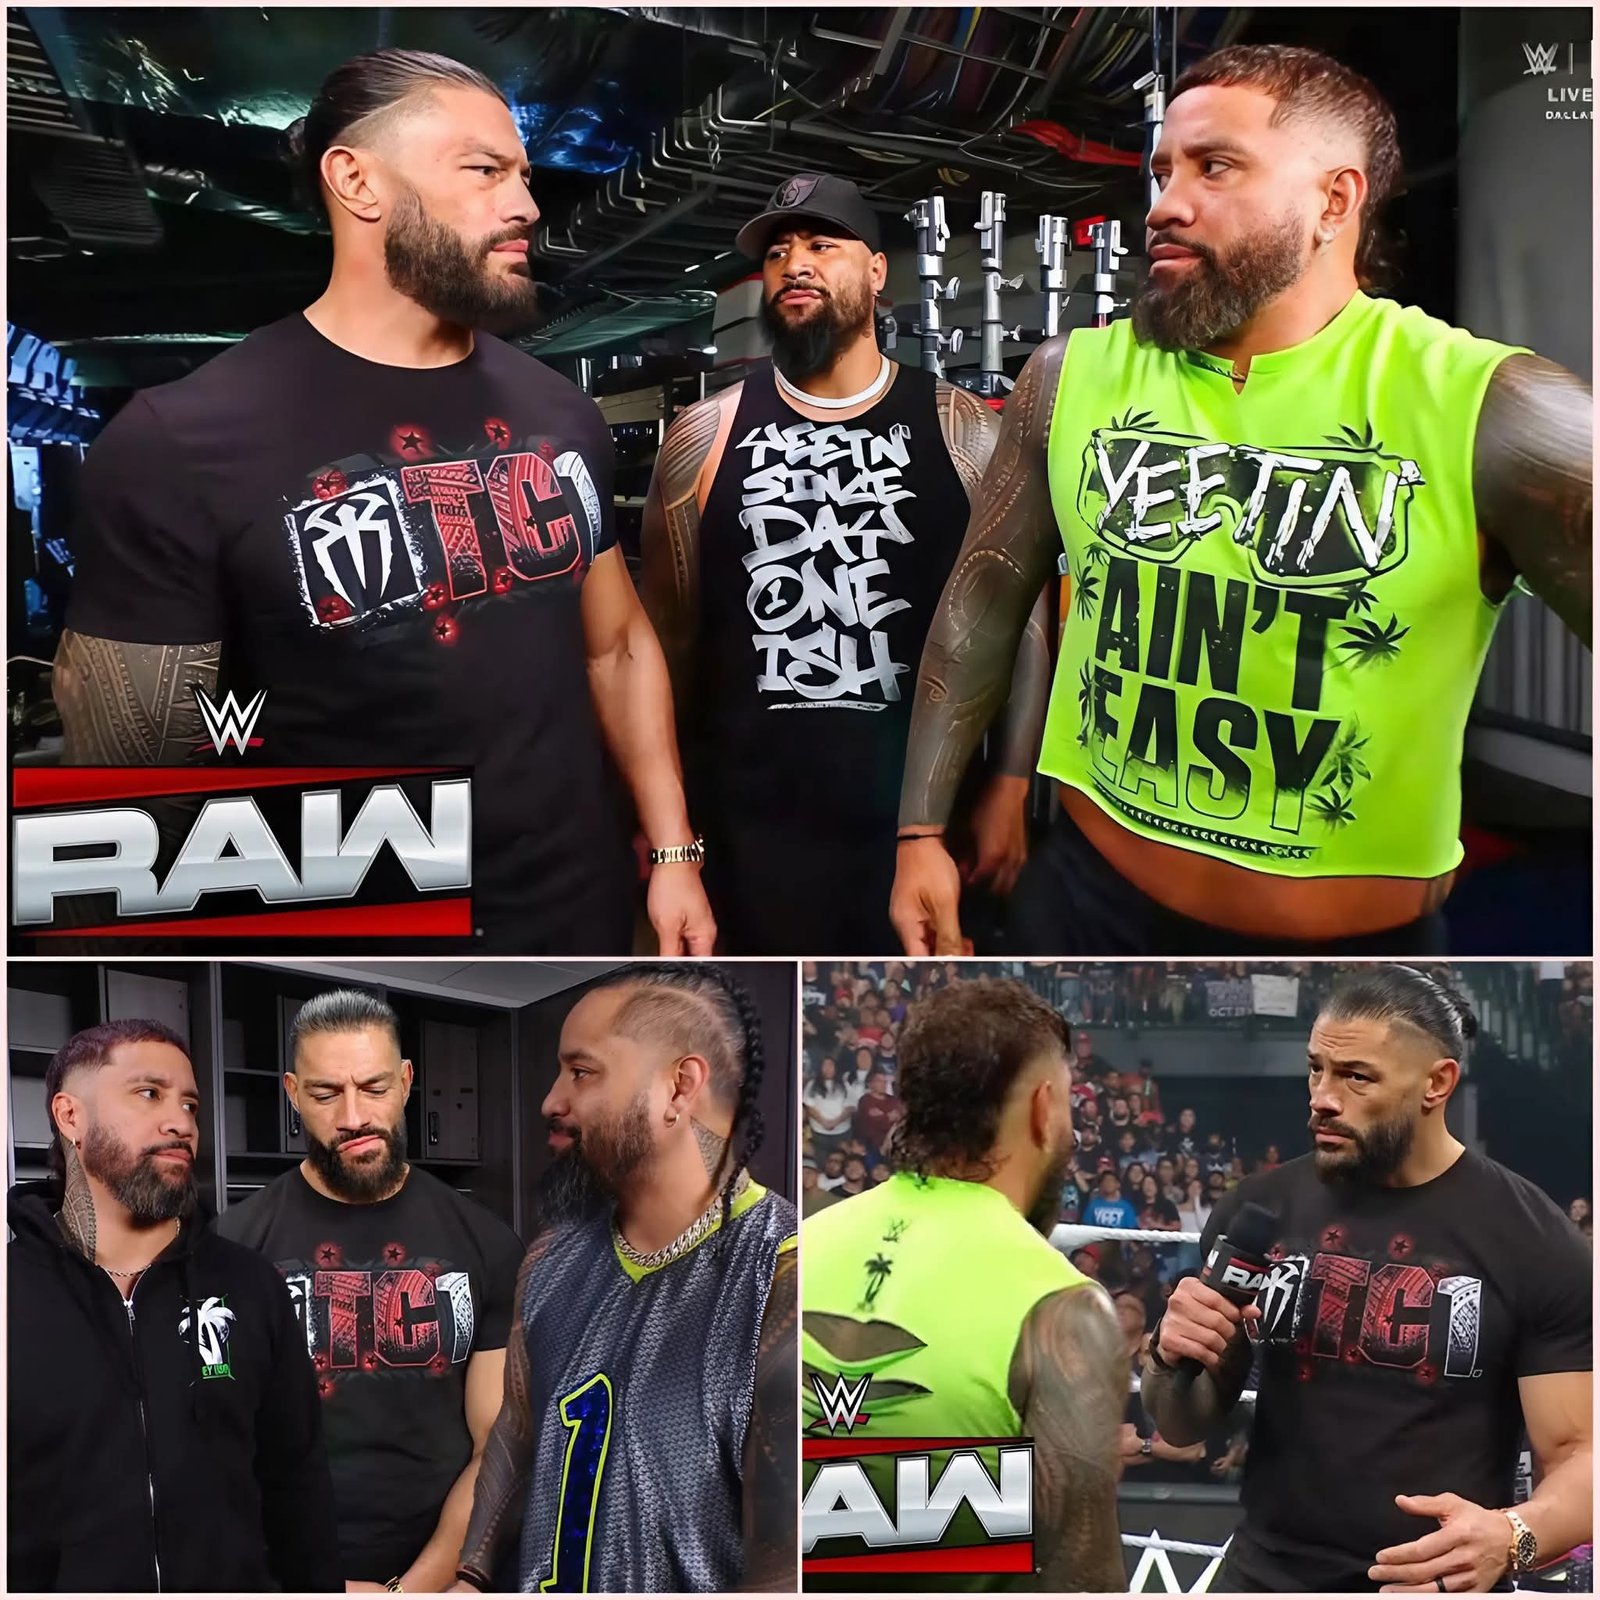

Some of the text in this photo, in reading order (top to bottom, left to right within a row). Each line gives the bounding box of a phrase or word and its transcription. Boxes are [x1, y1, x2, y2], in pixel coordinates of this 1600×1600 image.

[742, 462, 917, 506] SINCE
[738, 503, 915, 573] DAY
[746, 555, 912, 632] ONE
[752, 622, 911, 701] ISH
[1094, 556, 1352, 712] AIN'T
[1091, 663, 1342, 835] EASY
[1220, 1264, 1264, 1290] RA
[539, 1373, 613, 1593] 1
